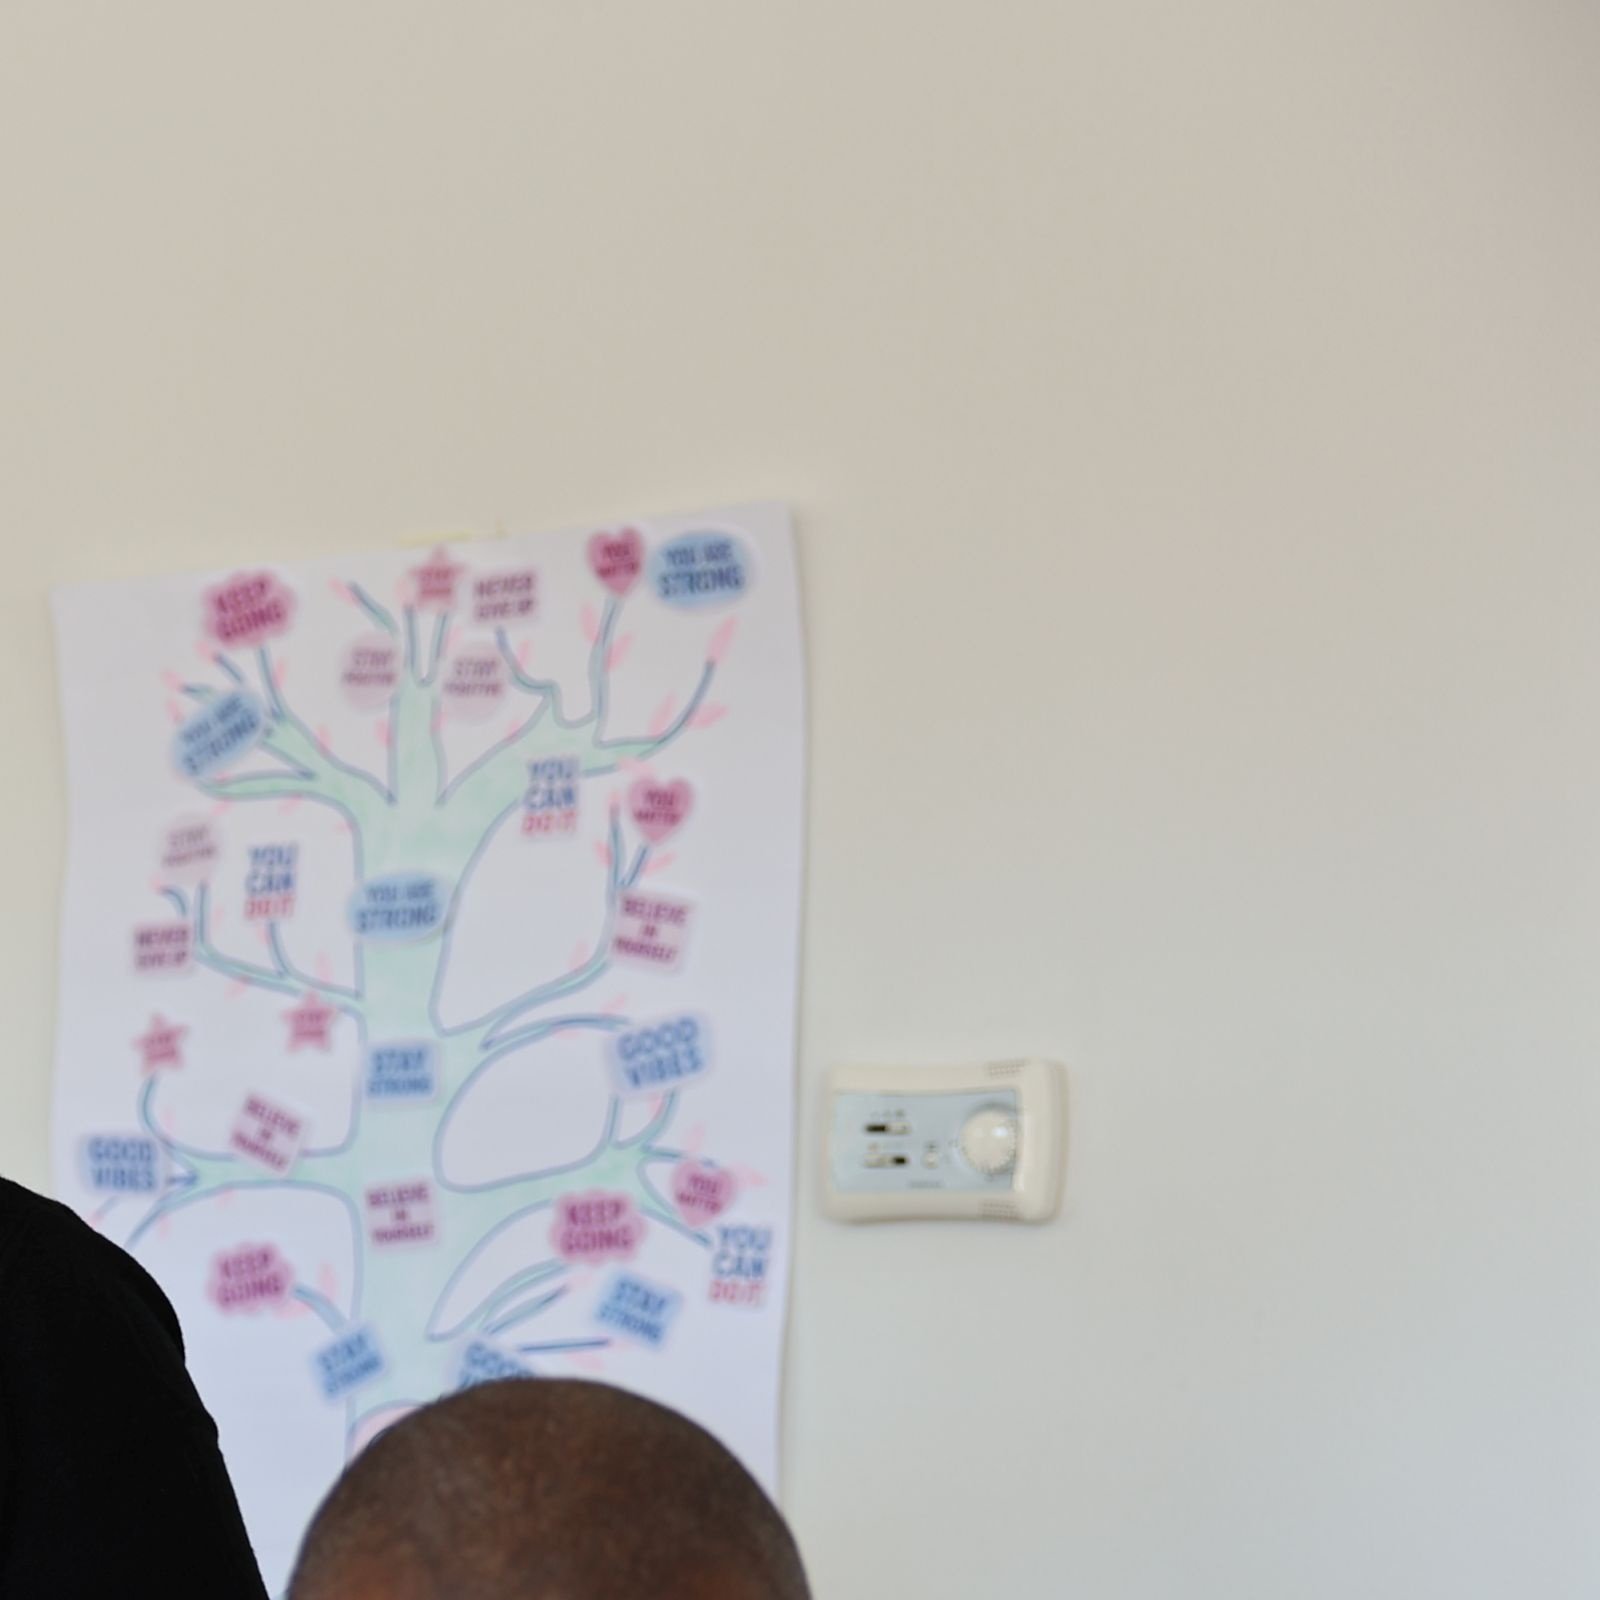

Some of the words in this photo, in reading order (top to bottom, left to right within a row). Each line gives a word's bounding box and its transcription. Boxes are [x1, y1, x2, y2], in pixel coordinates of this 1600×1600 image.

[665, 547, 697, 567] YOU
[659, 566, 745, 597] STRONG
[524, 784, 578, 810] CAN
[246, 872, 296, 894] CAN
[367, 883, 400, 902] YOU
[357, 902, 437, 934] STRONG
[617, 1016, 700, 1061] GOOD
[372, 1050, 426, 1074] STAY
[625, 1048, 703, 1090] VIBES
[87, 1138, 155, 1163] GOOD
[90, 1168, 155, 1192] VIBES
[566, 1201, 625, 1226] KEEP
[560, 1226, 632, 1252] GOING
[718, 1226, 772, 1250] YOU
[712, 1253, 766, 1278] CAN
